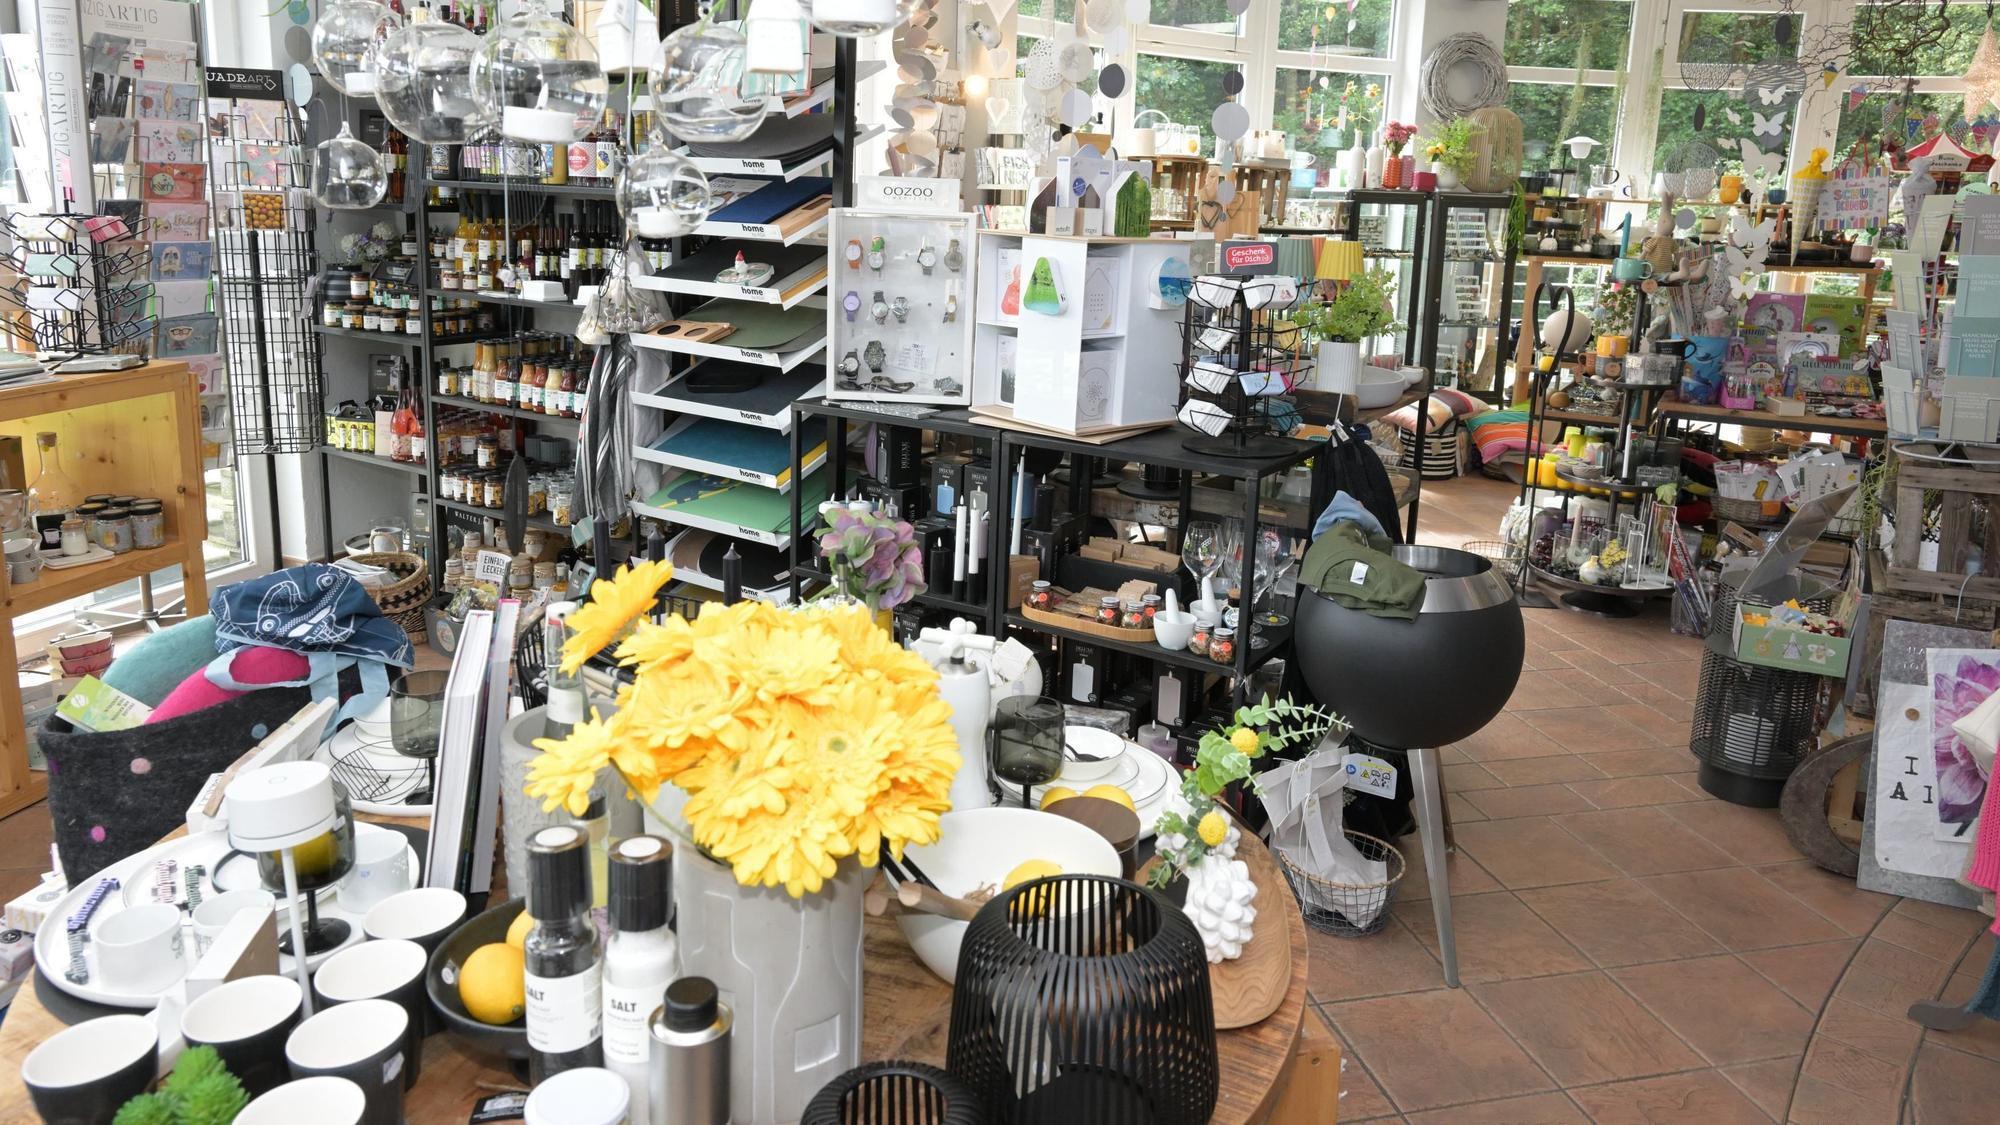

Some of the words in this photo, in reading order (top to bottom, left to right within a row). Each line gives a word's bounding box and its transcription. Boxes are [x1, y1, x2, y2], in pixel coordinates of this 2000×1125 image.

[742, 160, 765, 169] home
[883, 186, 933, 197] OOZOO
[742, 223, 765, 233] home
[1231, 248, 1266, 257] Geschenk
[1244, 255, 1261, 263] Dich
[741, 286, 764, 296] home
[740, 349, 763, 359] home
[740, 411, 762, 421] home
[739, 469, 761, 480] home
[454, 511, 476, 521] WALTER
[739, 526, 760, 537] home
[610, 998, 637, 1013] SALT
